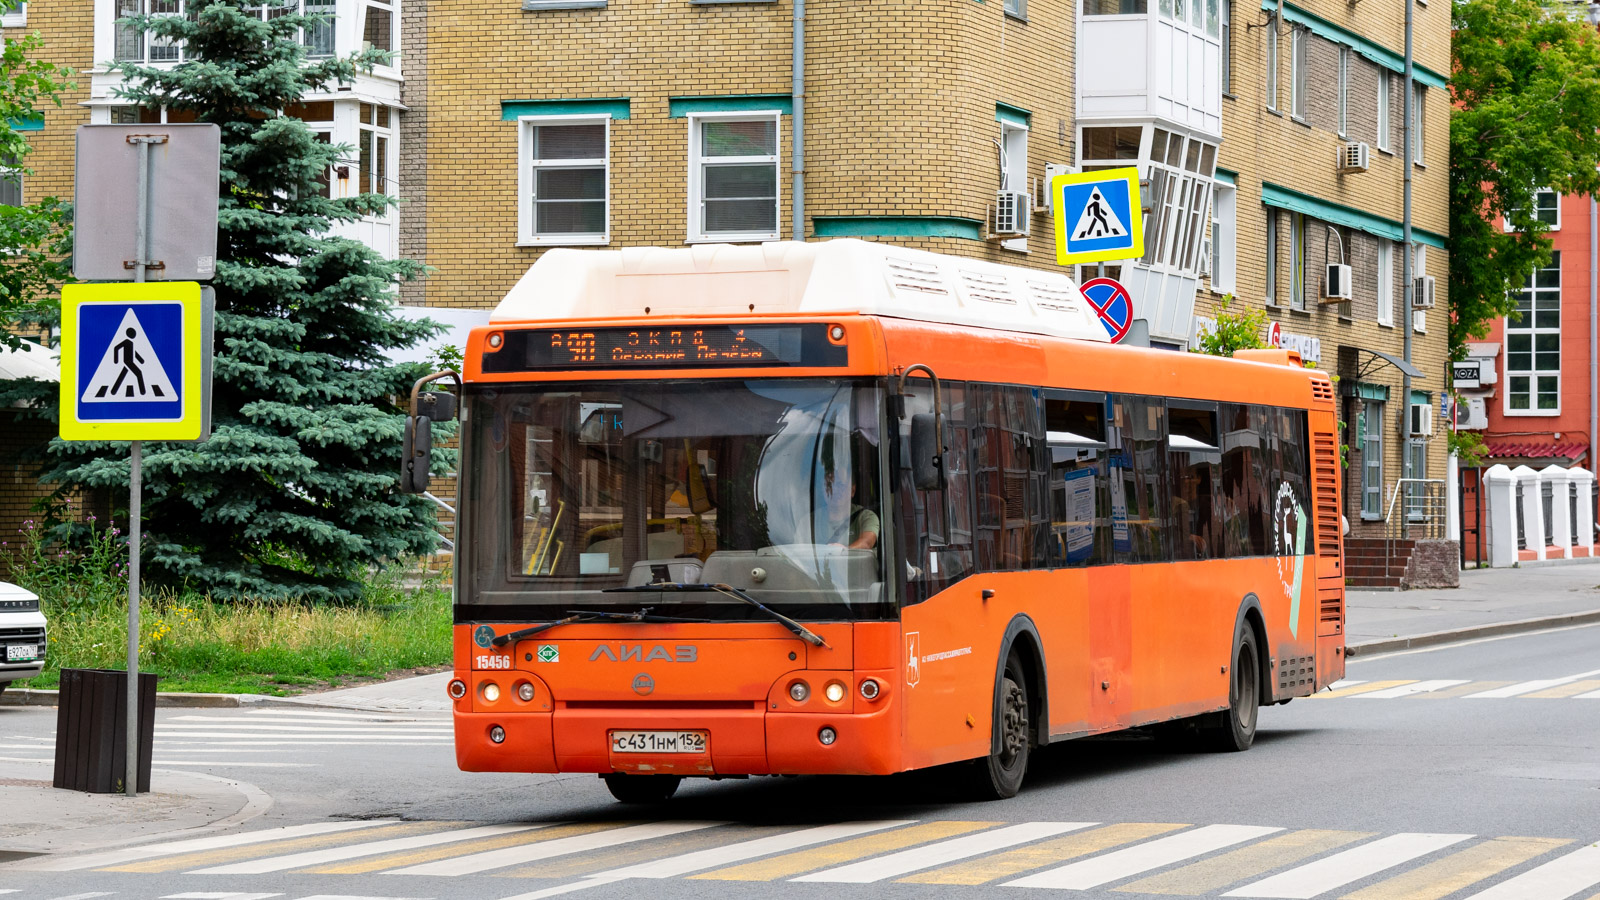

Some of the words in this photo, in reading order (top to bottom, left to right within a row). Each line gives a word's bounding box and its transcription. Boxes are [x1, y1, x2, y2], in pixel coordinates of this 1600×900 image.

[588, 645, 698, 662] ЛИАЗ
[476, 655, 511, 669] 15456
[618, 733, 677, 749] С431НМ
[679, 733, 702, 746] 152
